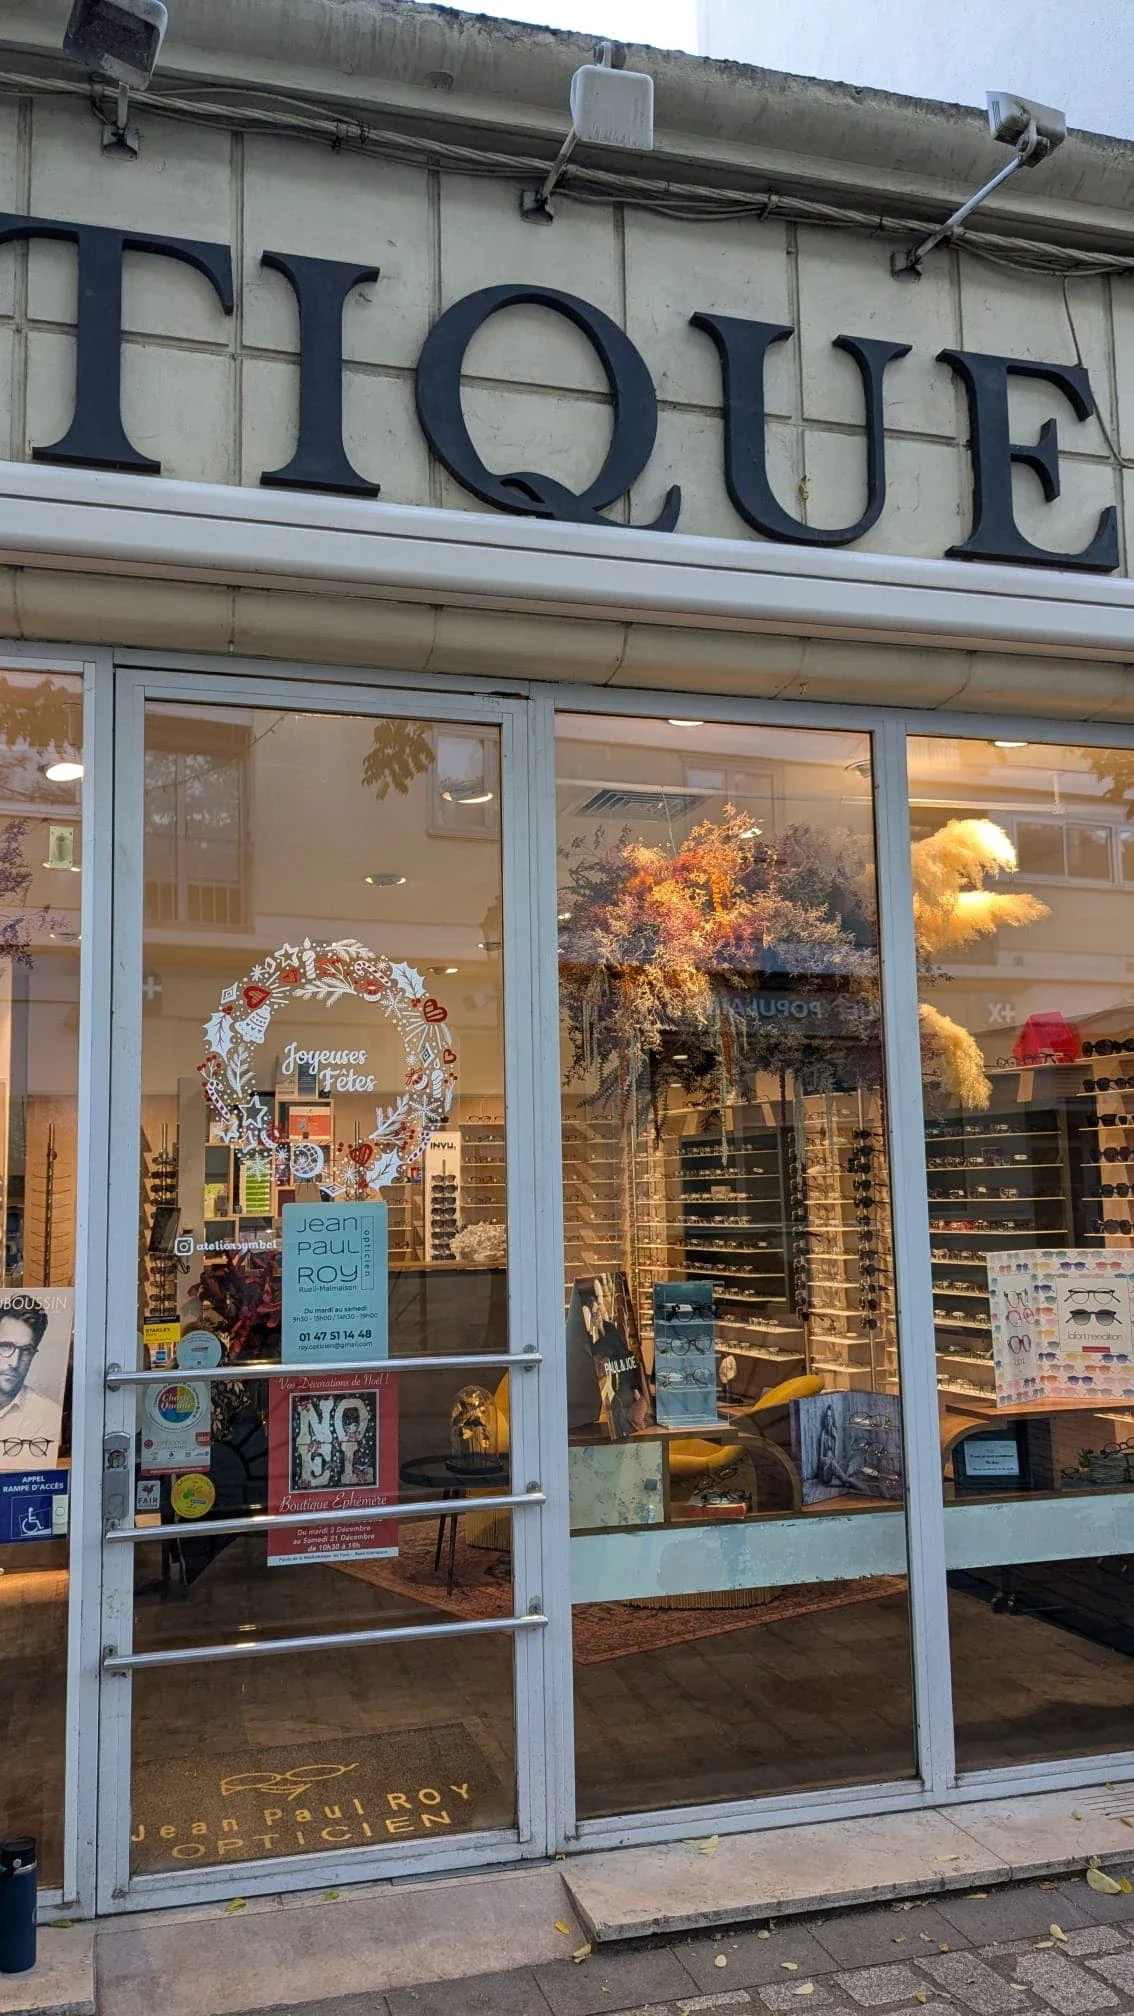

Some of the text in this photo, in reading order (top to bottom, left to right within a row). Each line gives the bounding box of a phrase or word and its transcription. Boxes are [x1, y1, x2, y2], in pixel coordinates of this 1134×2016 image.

[0, 213, 1119, 571] TIQUE
[282, 1042, 368, 1075] Joyeuses
[319, 1067, 378, 1092] Fêtes
[296, 1216, 358, 1233] Jean
[363, 1230, 371, 1276] opticien
[298, 1264, 358, 1284] ROY
[299, 1285, 358, 1293] Rueil-Malmaison
[300, 1330, 372, 1341] 01 47 51 14 48
[279, 1378, 296, 1389] Vos
[299, 1376, 349, 1390] Décorations
[351, 1374, 361, 1386] de
[3, 1482, 64, 1492] RAMPE D'ACCÈS
[279, 1495, 329, 1513] Boutique
[336, 1525, 371, 1533] Décembre
[303, 1536, 328, 1544] Samedi
[340, 1533, 375, 1541] Décembre
[319, 1543, 340, 1551] 10h30
[132, 1783, 469, 1842] Jean Paul ROY
[172, 1811, 451, 1859] OPTICIEN
